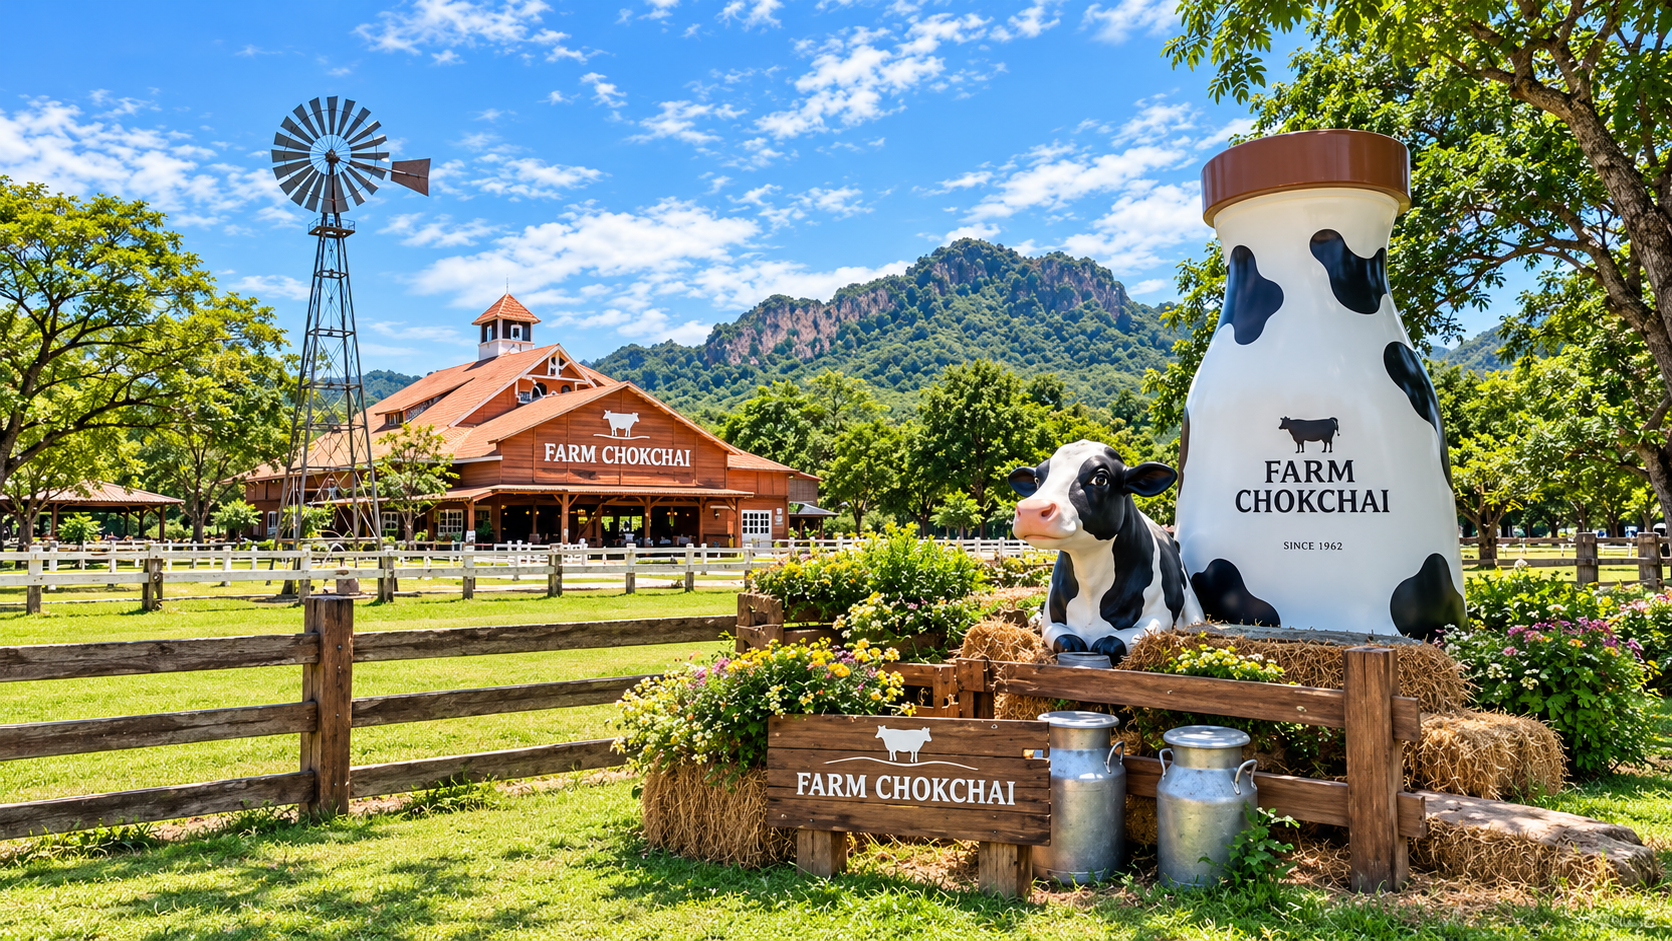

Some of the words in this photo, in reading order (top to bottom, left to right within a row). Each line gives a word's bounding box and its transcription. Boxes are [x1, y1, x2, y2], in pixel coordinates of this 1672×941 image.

[544, 443, 597, 463] FARM
[601, 445, 691, 467] CHOKCHAI
[1264, 460, 1355, 483] FARM
[1235, 489, 1390, 513] CHOKCHAI
[1283, 541, 1315, 550] SINCE
[1319, 541, 1343, 550] 1962
[796, 772, 868, 798] FARM
[875, 775, 1016, 805] CHOKCHAI
